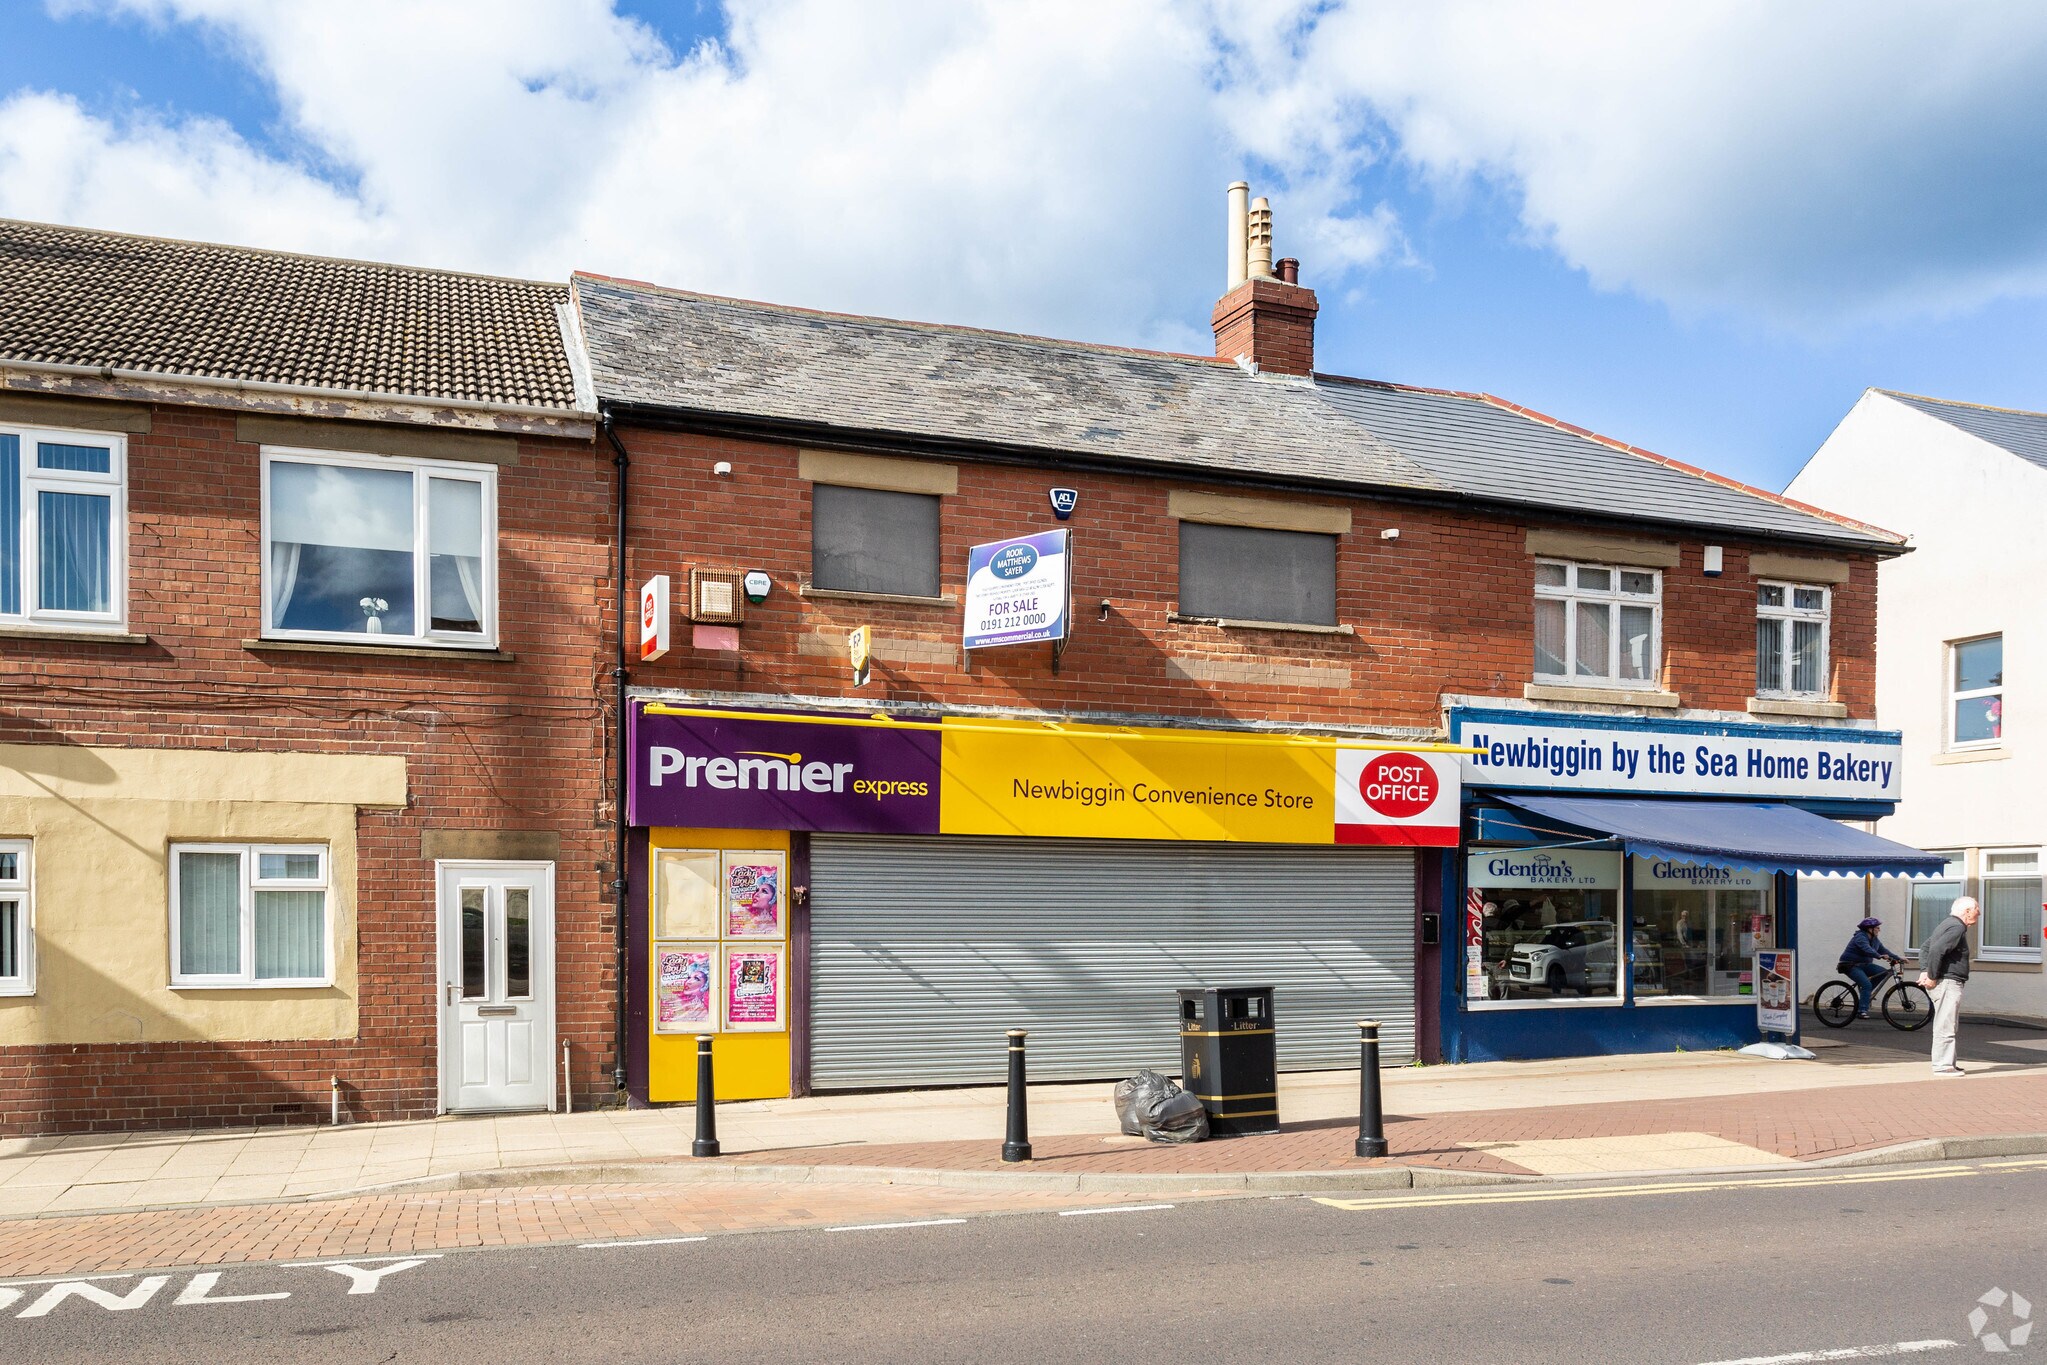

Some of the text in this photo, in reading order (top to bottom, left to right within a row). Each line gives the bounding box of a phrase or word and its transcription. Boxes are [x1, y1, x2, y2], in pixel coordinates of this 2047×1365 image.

[997, 555, 1032, 569] MATTHEWS
[1006, 548, 1023, 559] ROOK
[1004, 566, 1023, 577] SAYER
[989, 598, 1039, 616] FOR SALE
[980, 613, 1046, 631] 0191 212 0000
[975, 630, 1050, 645] www.rmscommercial.co.uk
[1472, 734, 1893, 788] Newbiggin by the Sea Home Bakery
[650, 746, 929, 801] Premier express
[1378, 766, 1424, 783] POST
[1013, 779, 1314, 809] Newbiggin Convenience Store
[1366, 784, 1430, 801] OFFICE
[1488, 859, 1573, 877] Glenton's
[1188, 1022, 1201, 1031] Litter
[1234, 1021, 1258, 1030] Litter
[0, 1260, 427, 1318] NLY
